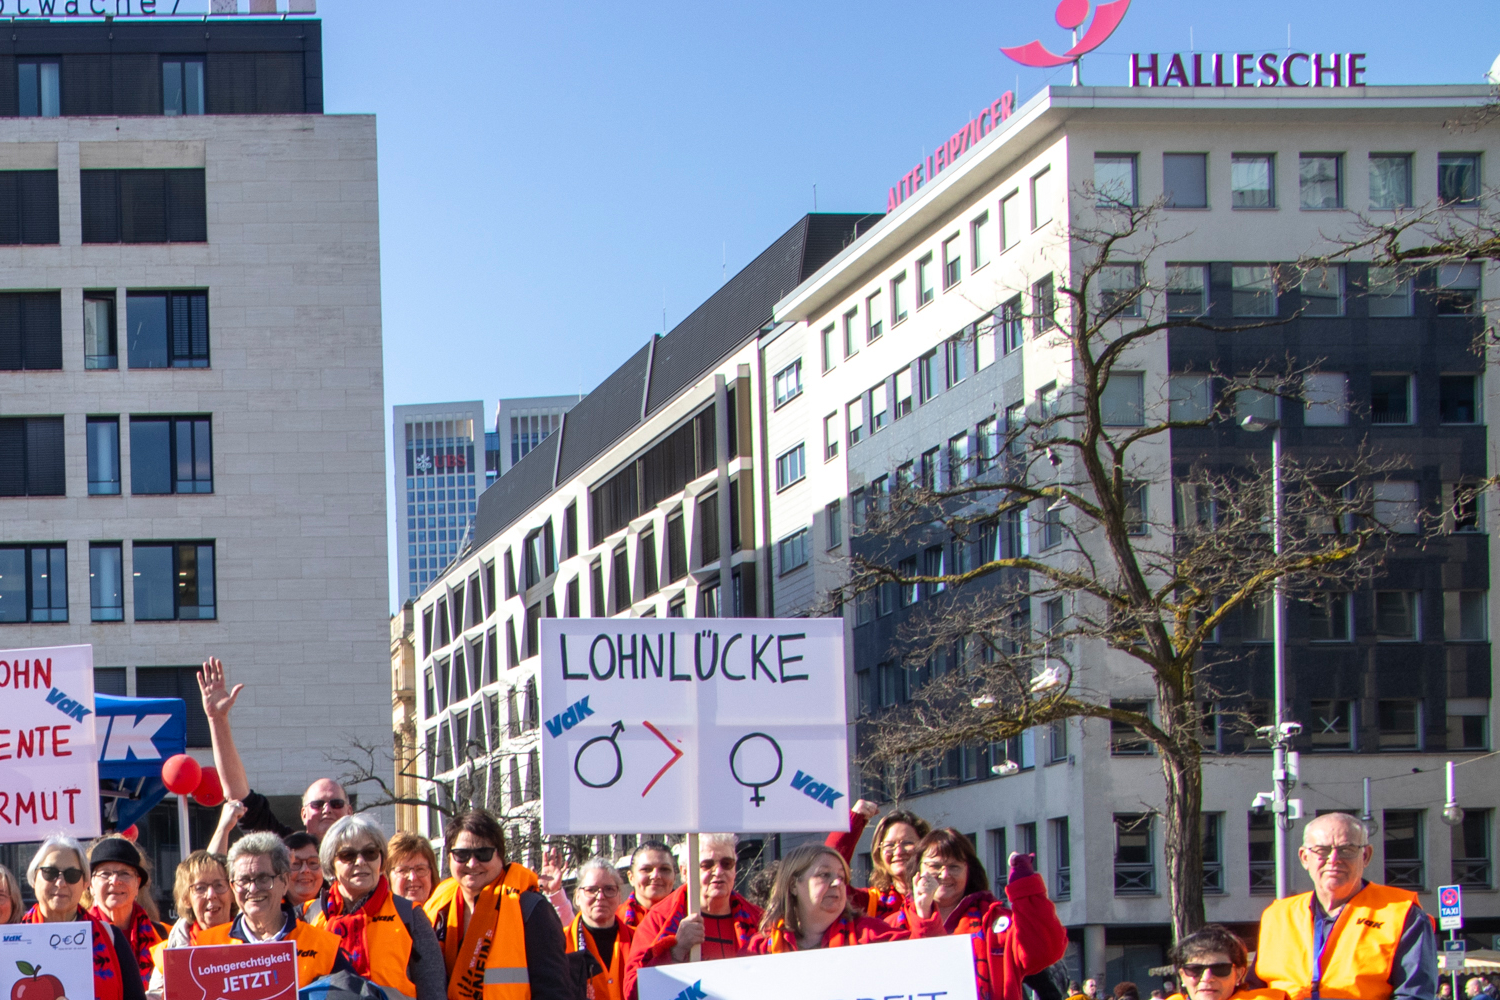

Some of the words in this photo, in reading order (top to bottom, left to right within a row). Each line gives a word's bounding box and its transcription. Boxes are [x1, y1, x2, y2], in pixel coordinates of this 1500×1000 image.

[1129, 52, 1367, 88] HALLESCHE
[886, 163, 923, 215] ALTE
[925, 90, 1015, 184] LEIPZIGER
[434, 454, 466, 468] UBS
[560, 629, 809, 684] LOHNLÜCKE
[45, 687, 93, 724] VdK
[544, 695, 596, 739] VdK
[789, 769, 845, 810] VdK
[1441, 907, 1459, 916] TAXI
[198, 952, 291, 976] Lohngerechtigkeit
